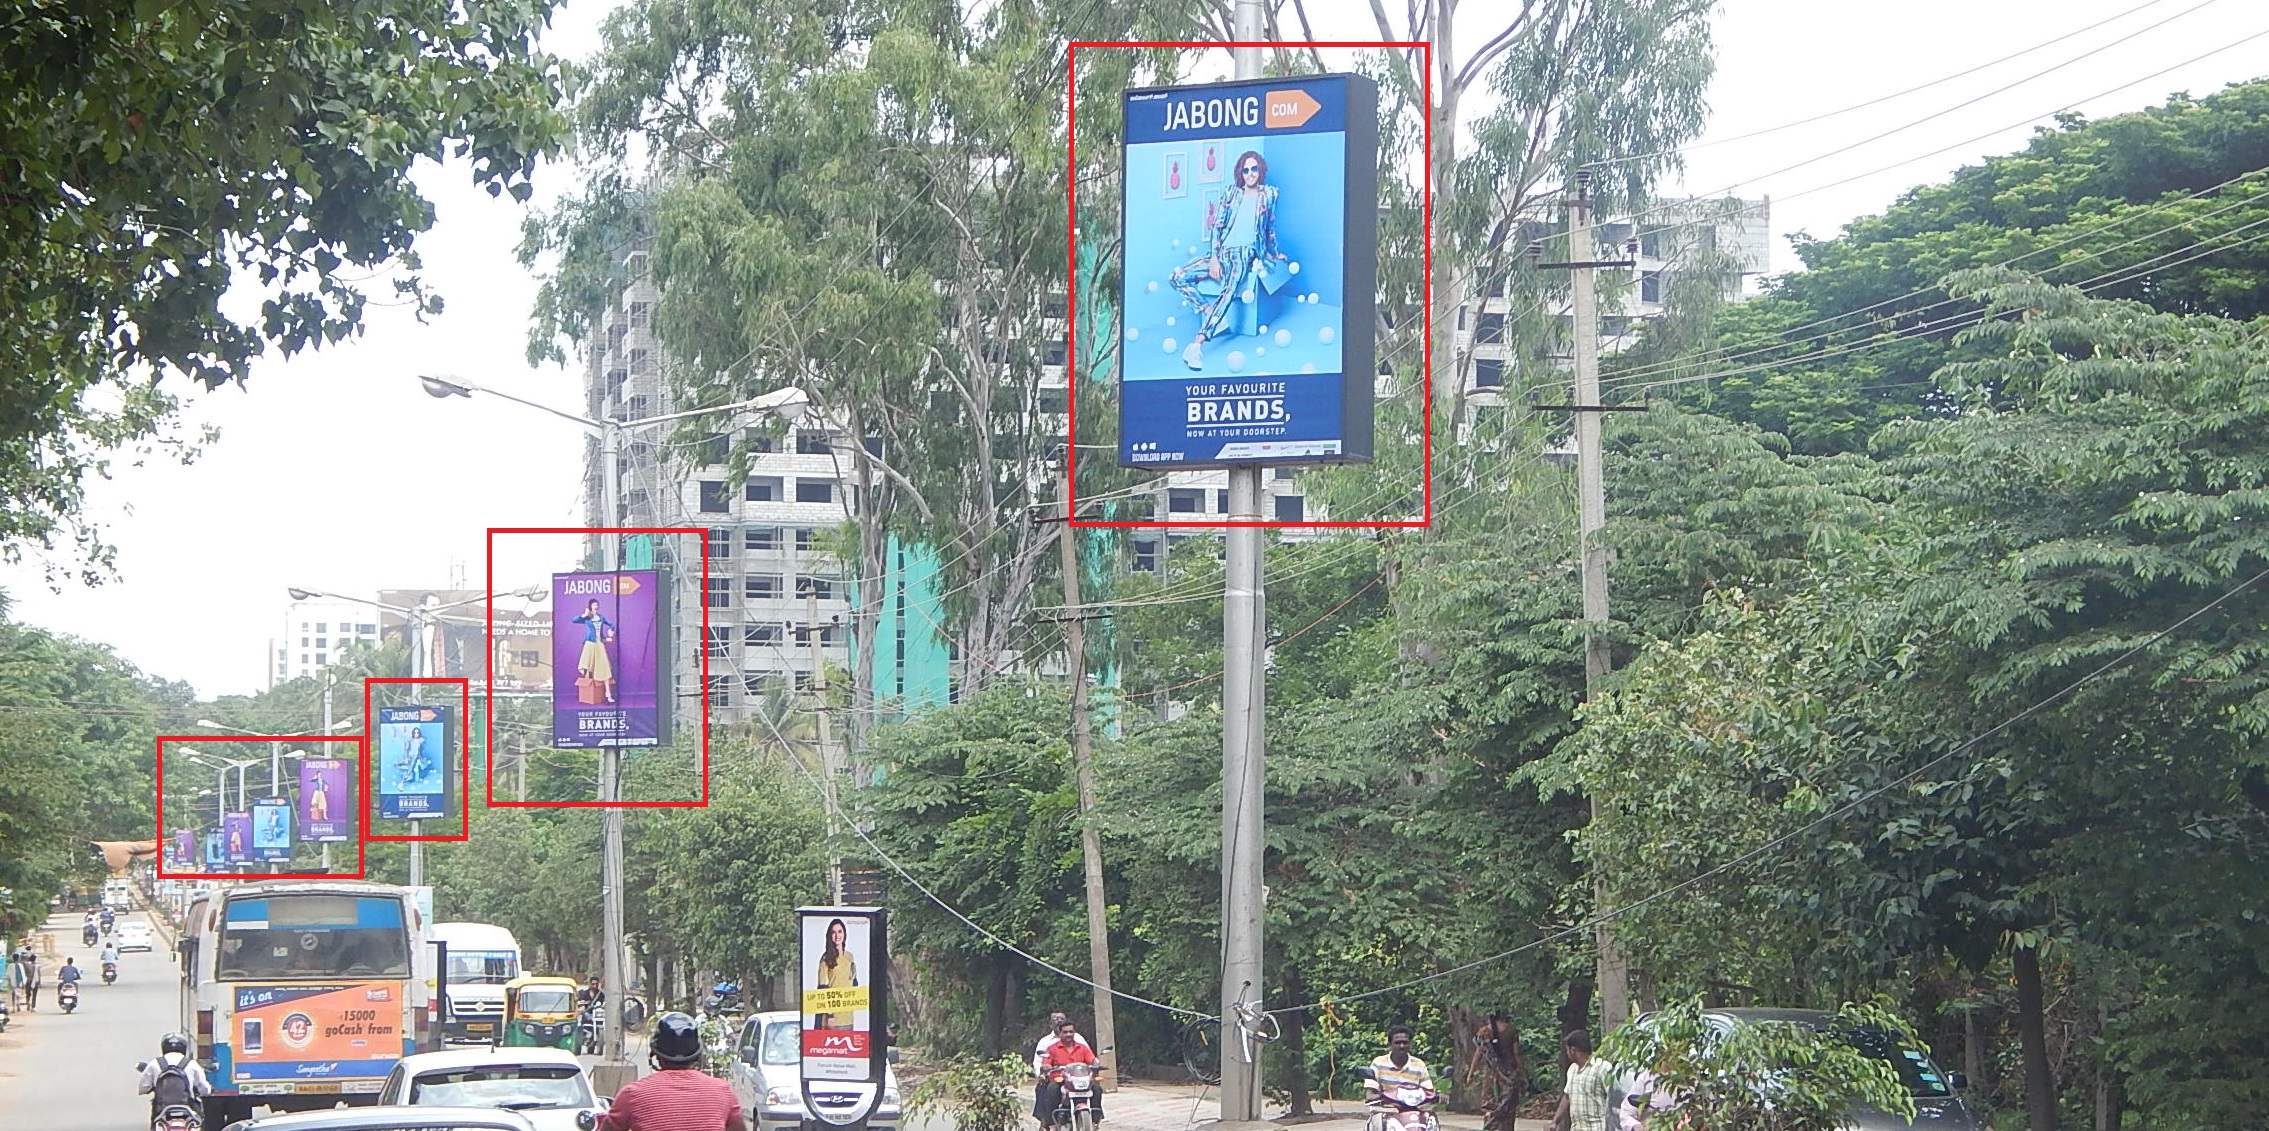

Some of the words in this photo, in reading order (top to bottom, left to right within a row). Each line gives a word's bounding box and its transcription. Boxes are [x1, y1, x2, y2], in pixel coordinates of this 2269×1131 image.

[1163, 97, 1259, 131] JABONG
[1271, 102, 1298, 117] COM
[1186, 384, 1216, 395] YOUR
[1221, 382, 1286, 394] FAVOURITE
[1187, 400, 1291, 422] BRANDS,
[1186, 429, 1205, 438] NOW
[1207, 429, 1217, 437] AT
[1219, 428, 1240, 437] YOUR
[564, 579, 611, 595] JABONG
[807, 993, 816, 1001] UP
[826, 990, 842, 999] 50%
[844, 990, 856, 998] OFF
[827, 1000, 841, 1008] 100
[842, 999, 868, 1007] BRANDS
[368, 1022, 392, 1034] from
[809, 1047, 848, 1056] megamart
